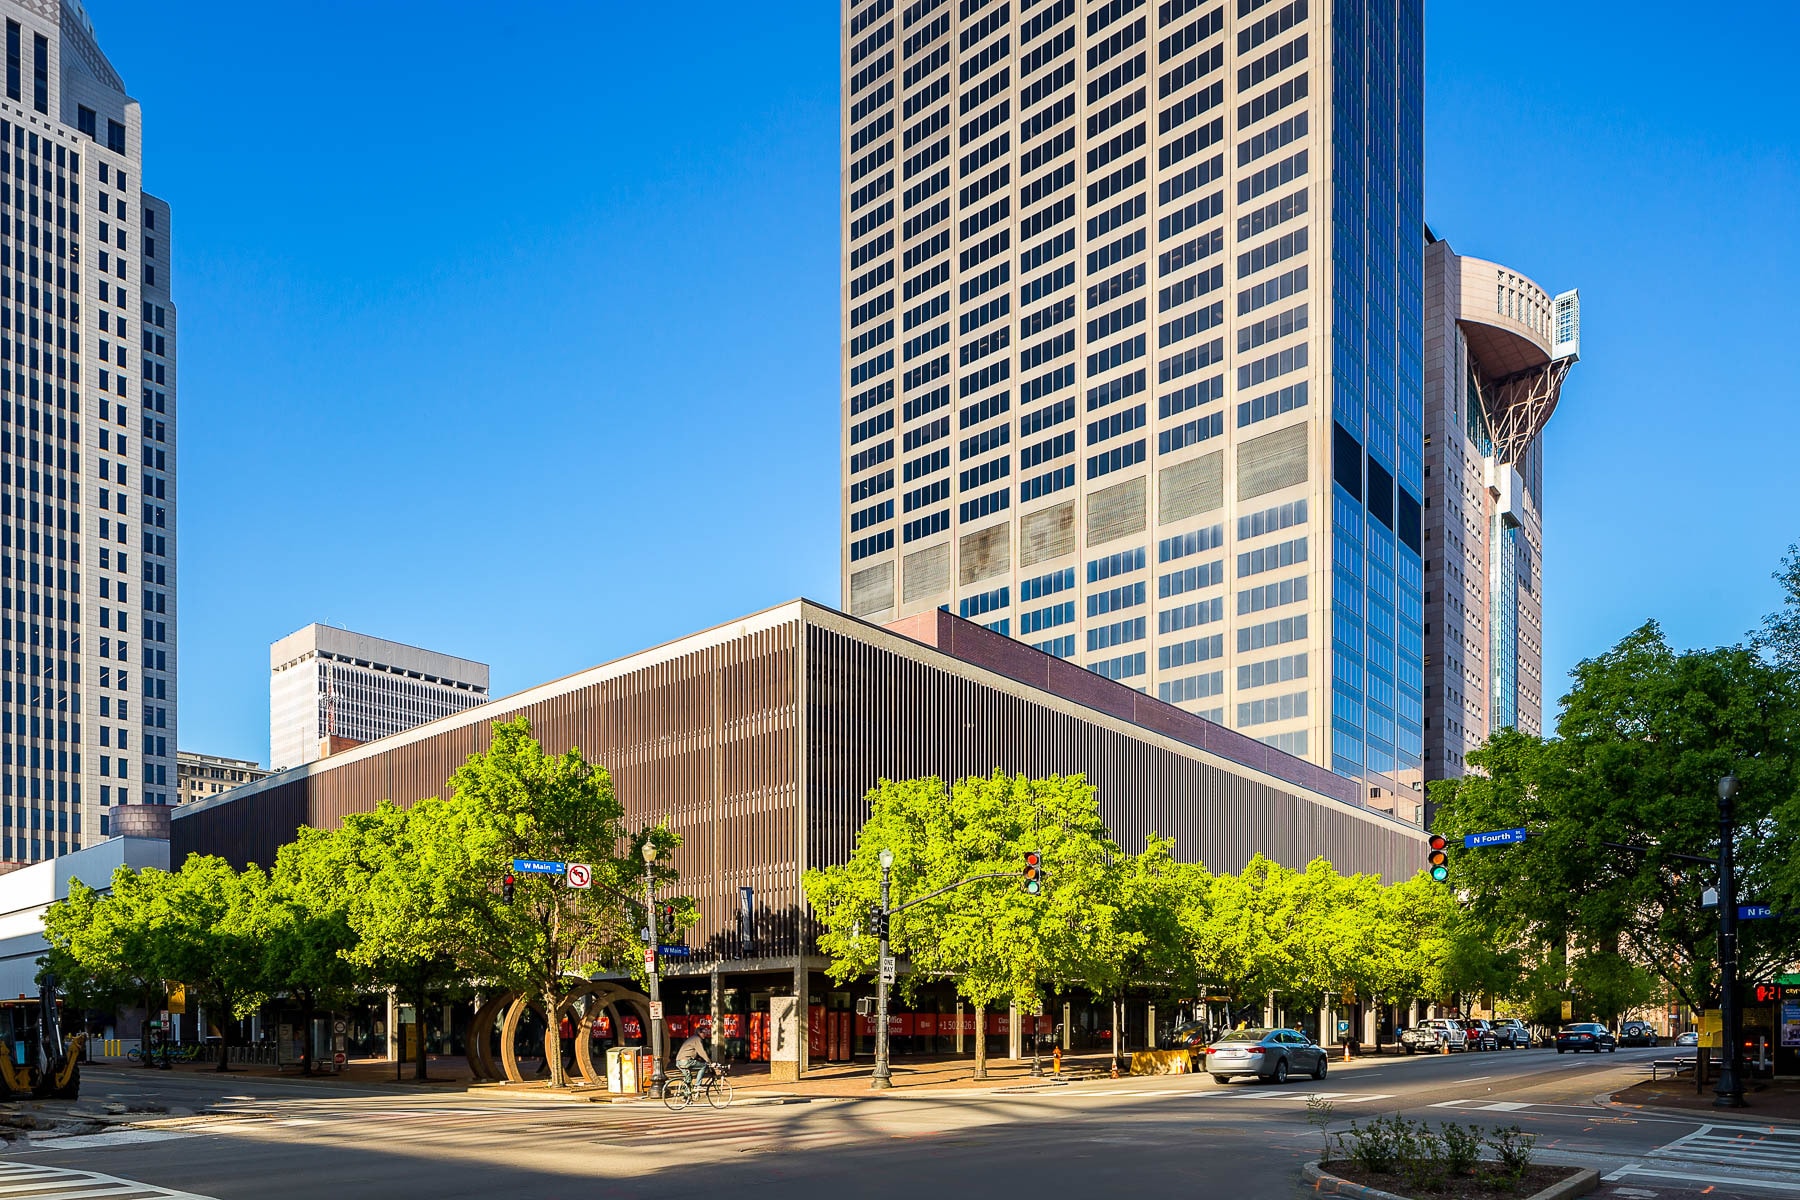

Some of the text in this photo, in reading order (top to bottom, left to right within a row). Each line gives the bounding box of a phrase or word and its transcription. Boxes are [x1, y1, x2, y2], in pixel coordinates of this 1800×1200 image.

[1482, 833, 1510, 843] Fourth
[1747, 908, 1756, 916] N
[1768, 986, 1781, 1000] 21
